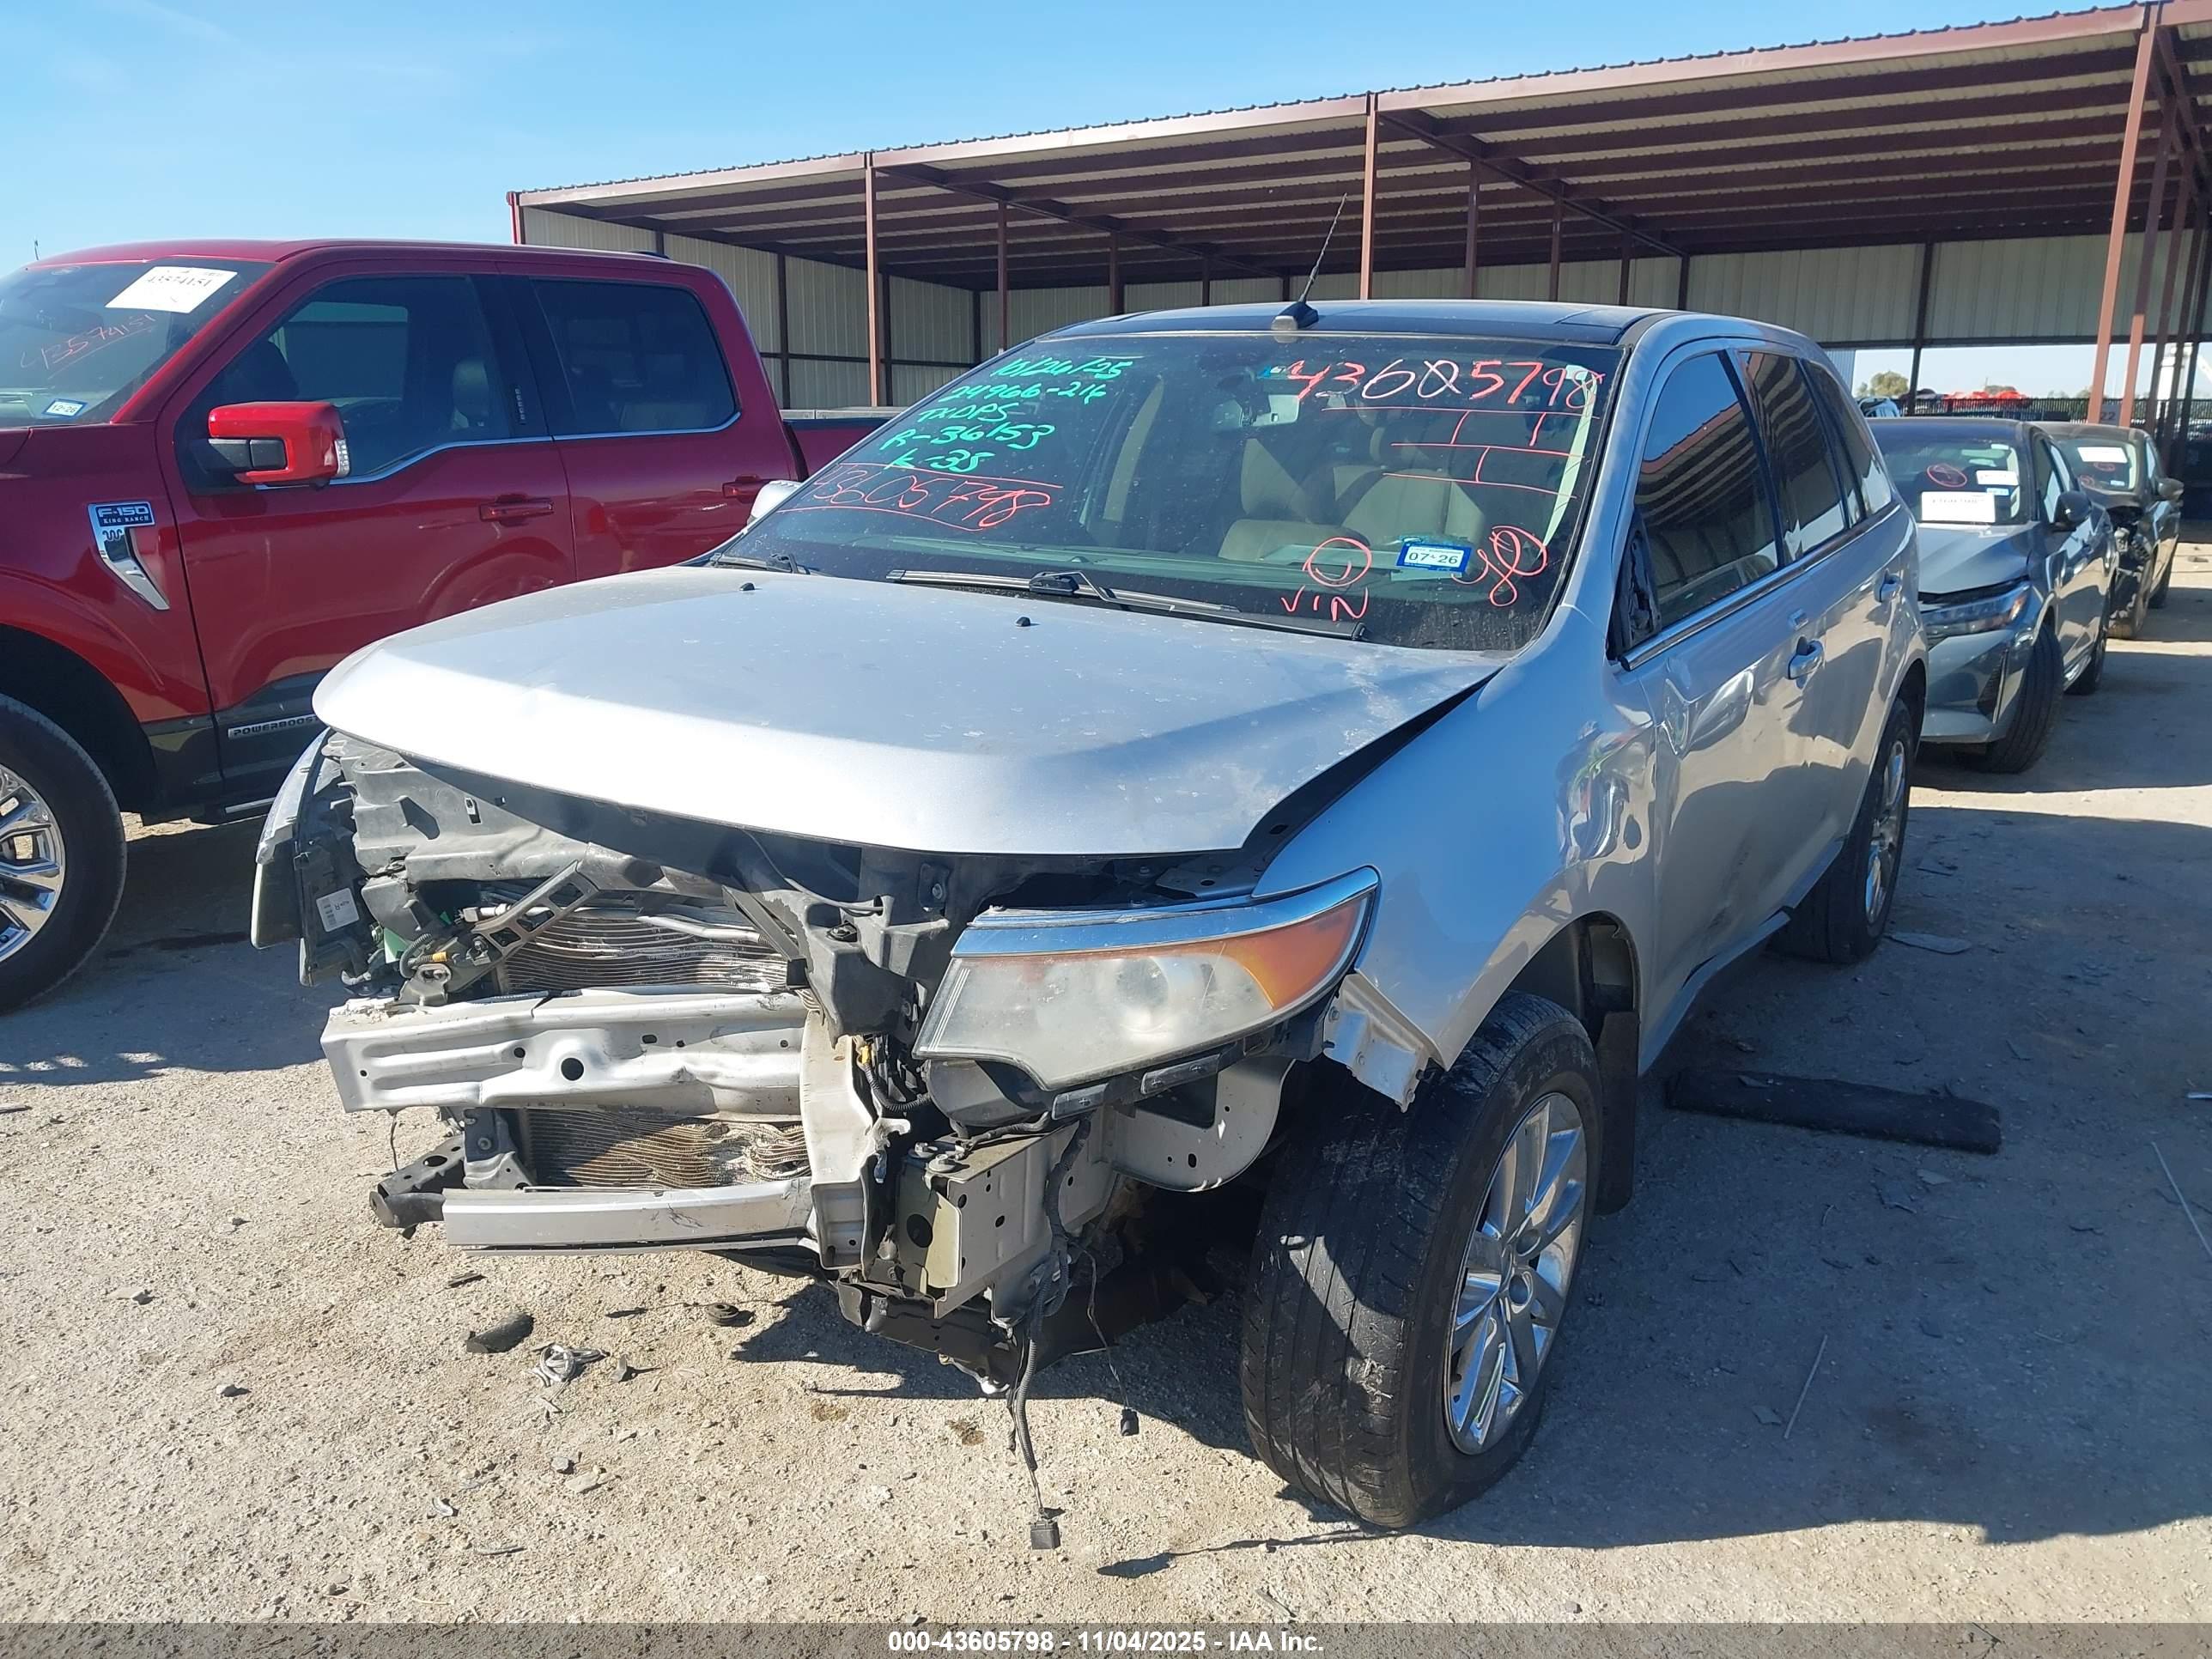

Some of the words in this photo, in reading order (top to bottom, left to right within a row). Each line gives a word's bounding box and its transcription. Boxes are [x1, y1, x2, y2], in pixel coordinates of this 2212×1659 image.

[1286, 358, 1607, 409] 43605798
[97, 505, 149, 518] F-150
[125, 514, 150, 523] RANCH
[1280, 584, 1369, 622] VIN
